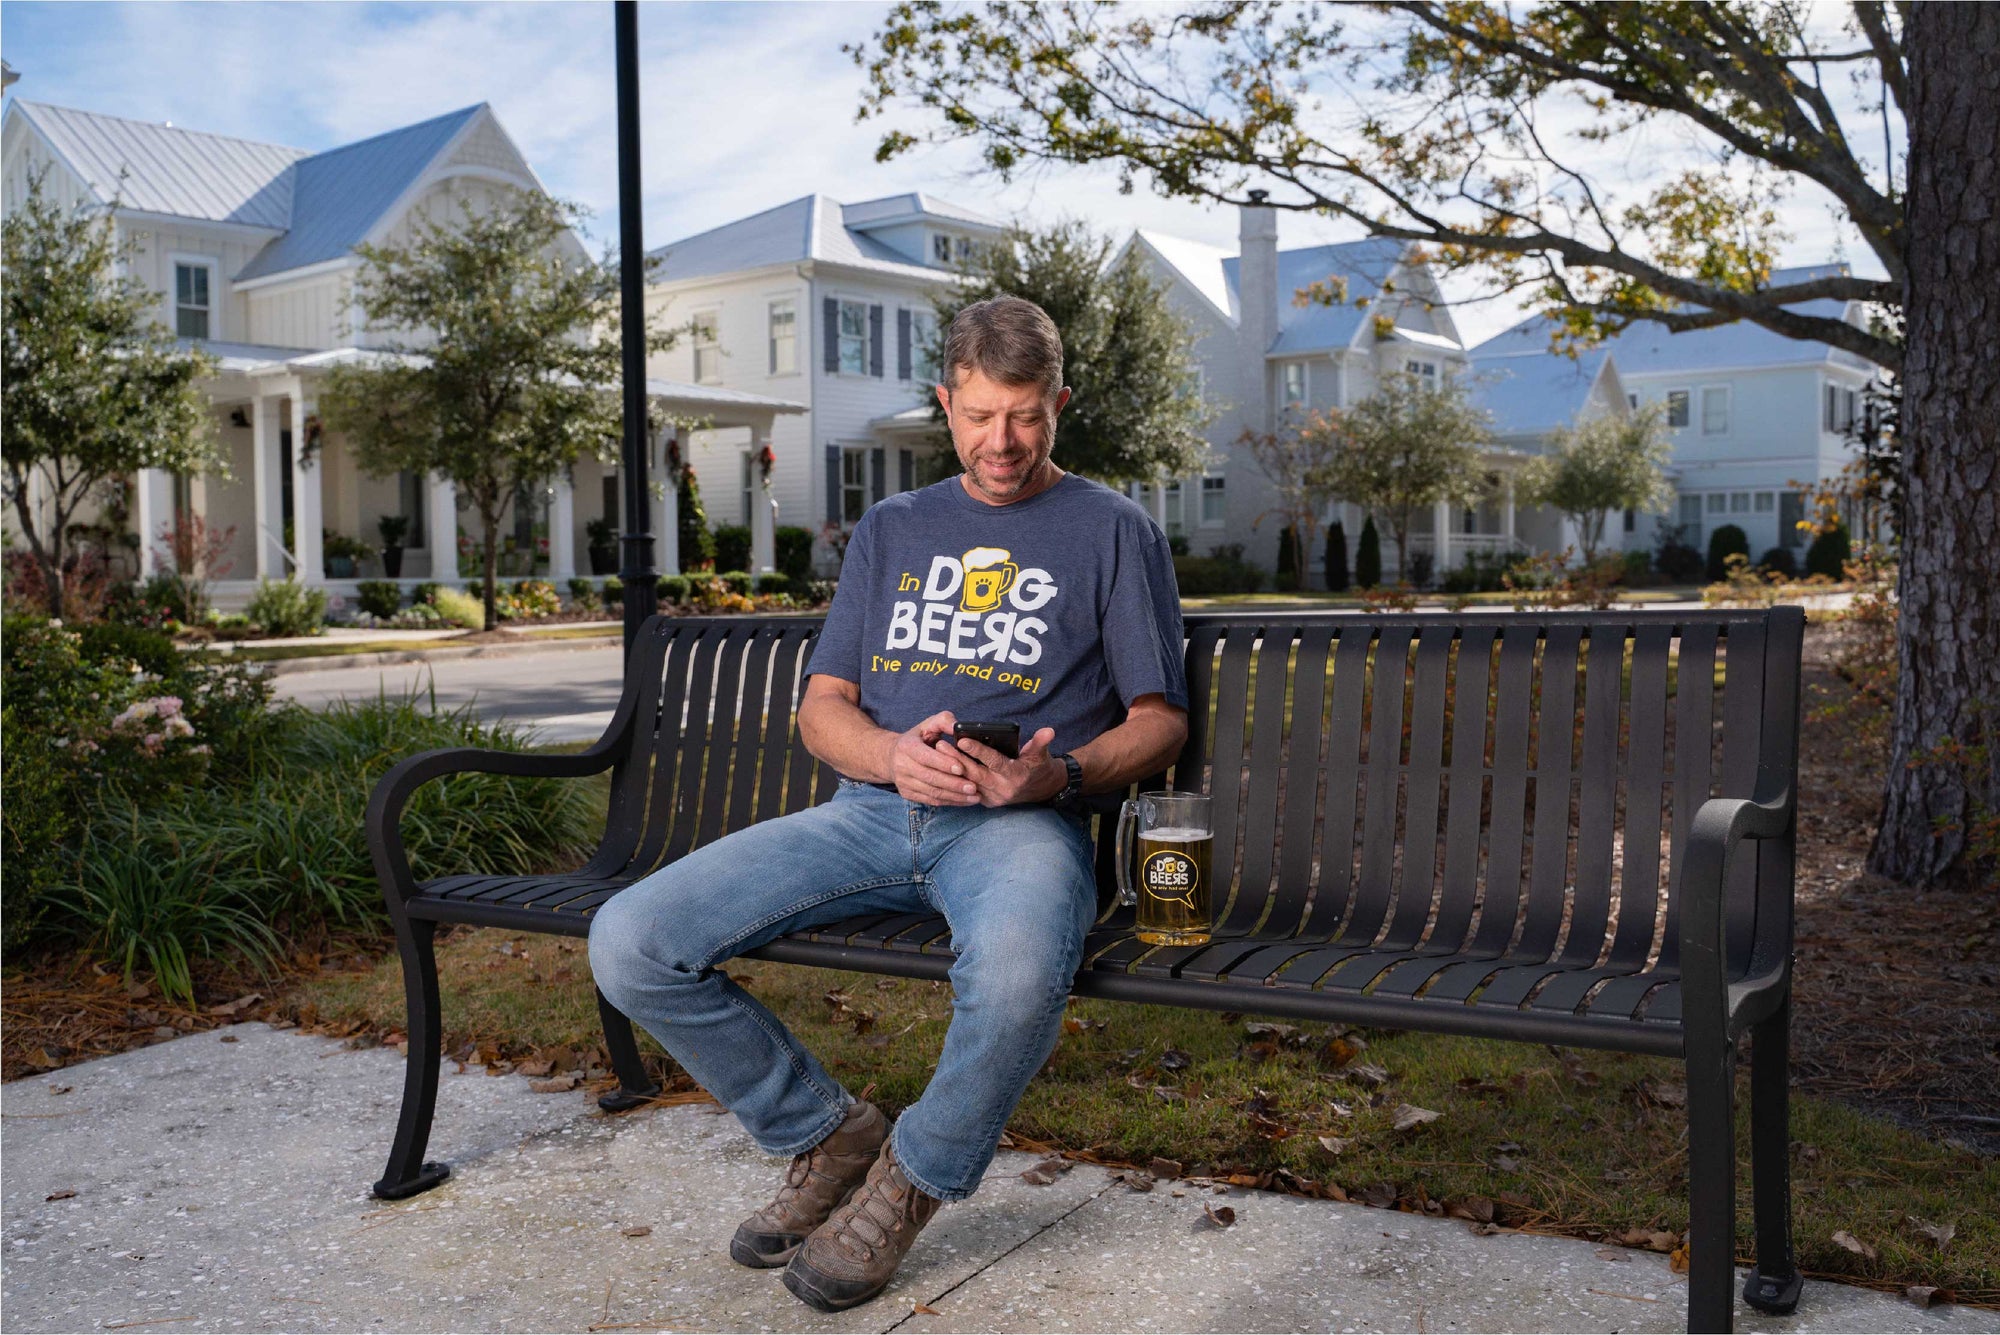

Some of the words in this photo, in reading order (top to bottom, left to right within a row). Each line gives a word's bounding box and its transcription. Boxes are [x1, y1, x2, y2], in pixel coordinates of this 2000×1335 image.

[898, 573, 920, 591] In
[886, 601, 1048, 665] BEERS
[871, 655, 901, 672] I've
[910, 659, 949, 676] only
[998, 672, 1041, 694] one!
[1150, 871, 1188, 885] BEERS
